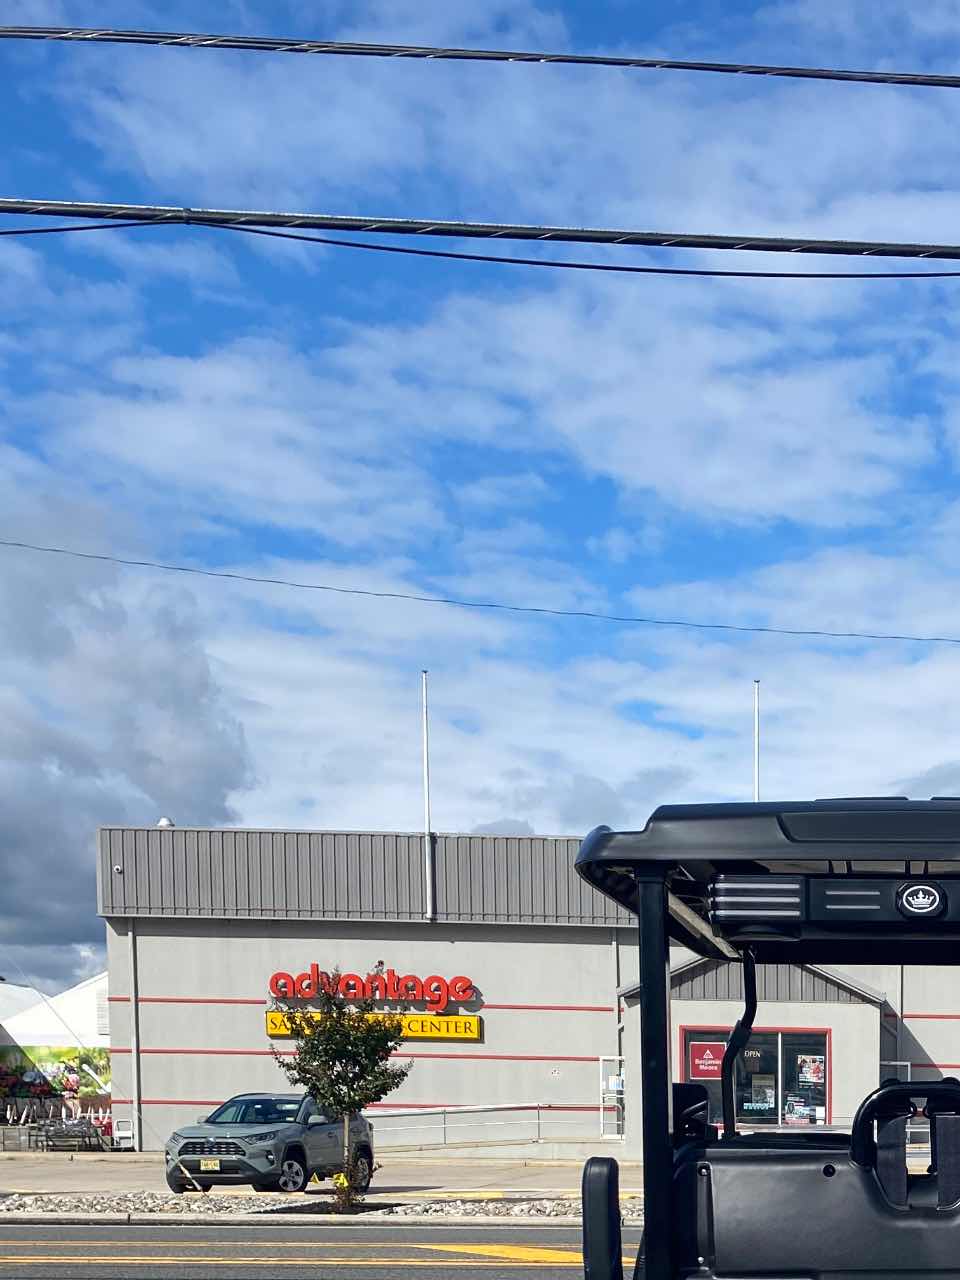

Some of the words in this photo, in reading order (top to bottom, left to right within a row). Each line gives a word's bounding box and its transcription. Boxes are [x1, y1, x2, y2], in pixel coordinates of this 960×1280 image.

[269, 962, 474, 1012] advantage
[407, 1019, 475, 1034] CENTER
[744, 1050, 761, 1059] OPEN
